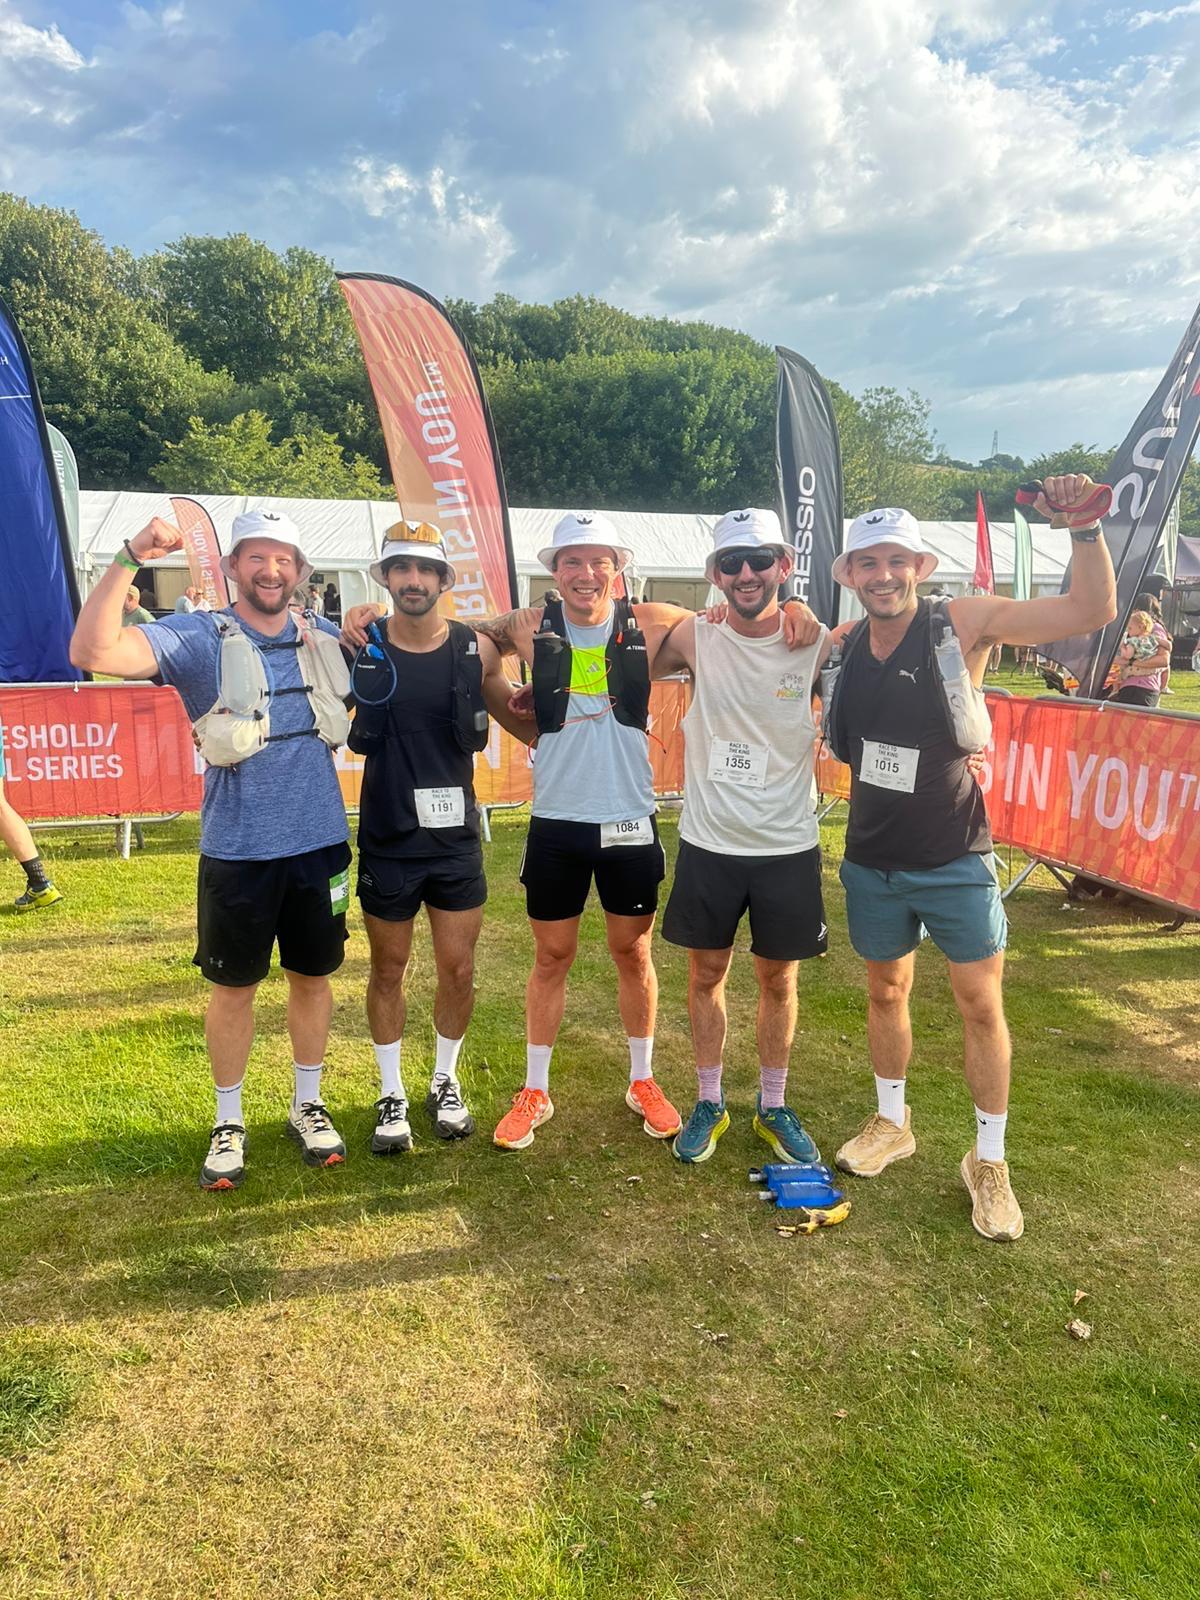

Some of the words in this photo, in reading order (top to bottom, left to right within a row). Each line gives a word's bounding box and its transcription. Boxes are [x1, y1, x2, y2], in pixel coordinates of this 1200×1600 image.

[793, 466, 816, 602] RESSIO
[27, 754, 124, 781] SERIES
[725, 757, 751, 770] 1355
[875, 759, 900, 773] 1015
[1004, 740, 1053, 811] IN
[431, 802, 453, 813] 1191
[615, 821, 640, 834] 1084
